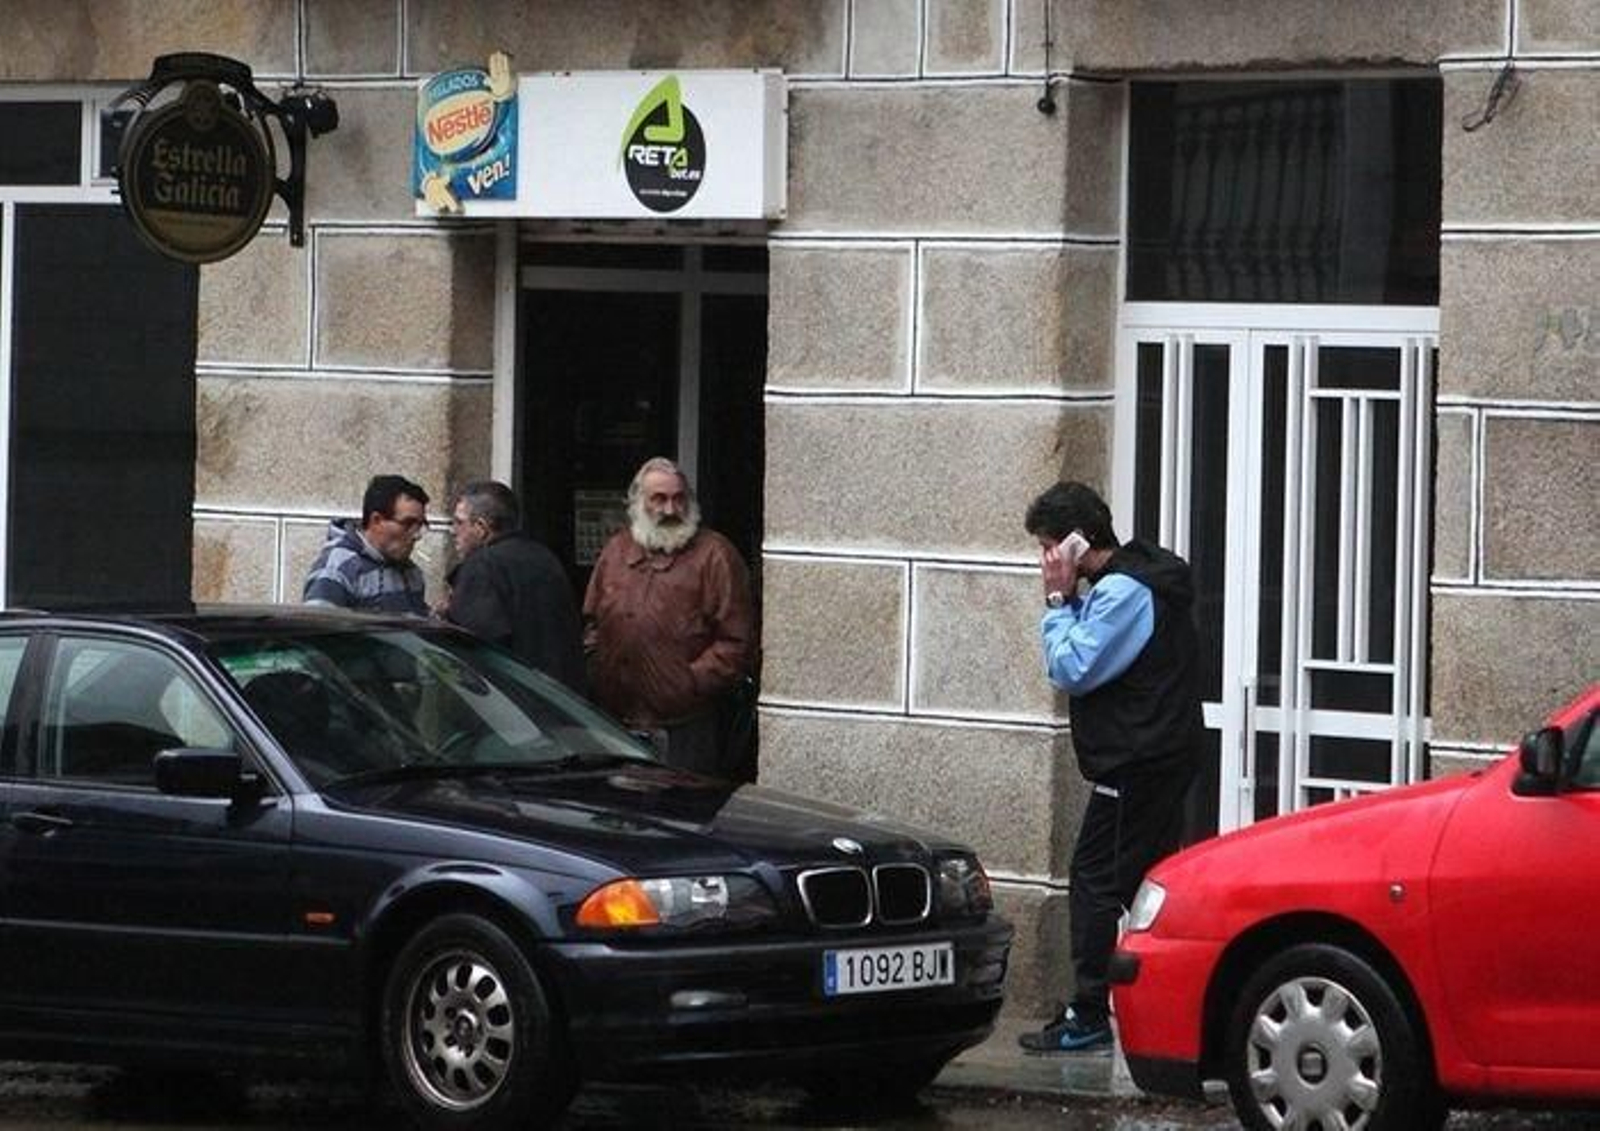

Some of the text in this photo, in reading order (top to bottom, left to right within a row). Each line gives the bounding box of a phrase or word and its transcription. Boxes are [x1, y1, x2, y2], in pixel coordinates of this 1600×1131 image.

[153, 138, 246, 174] Estrella
[156, 173, 240, 207] Galicia
[847, 951, 905, 987] 1092
